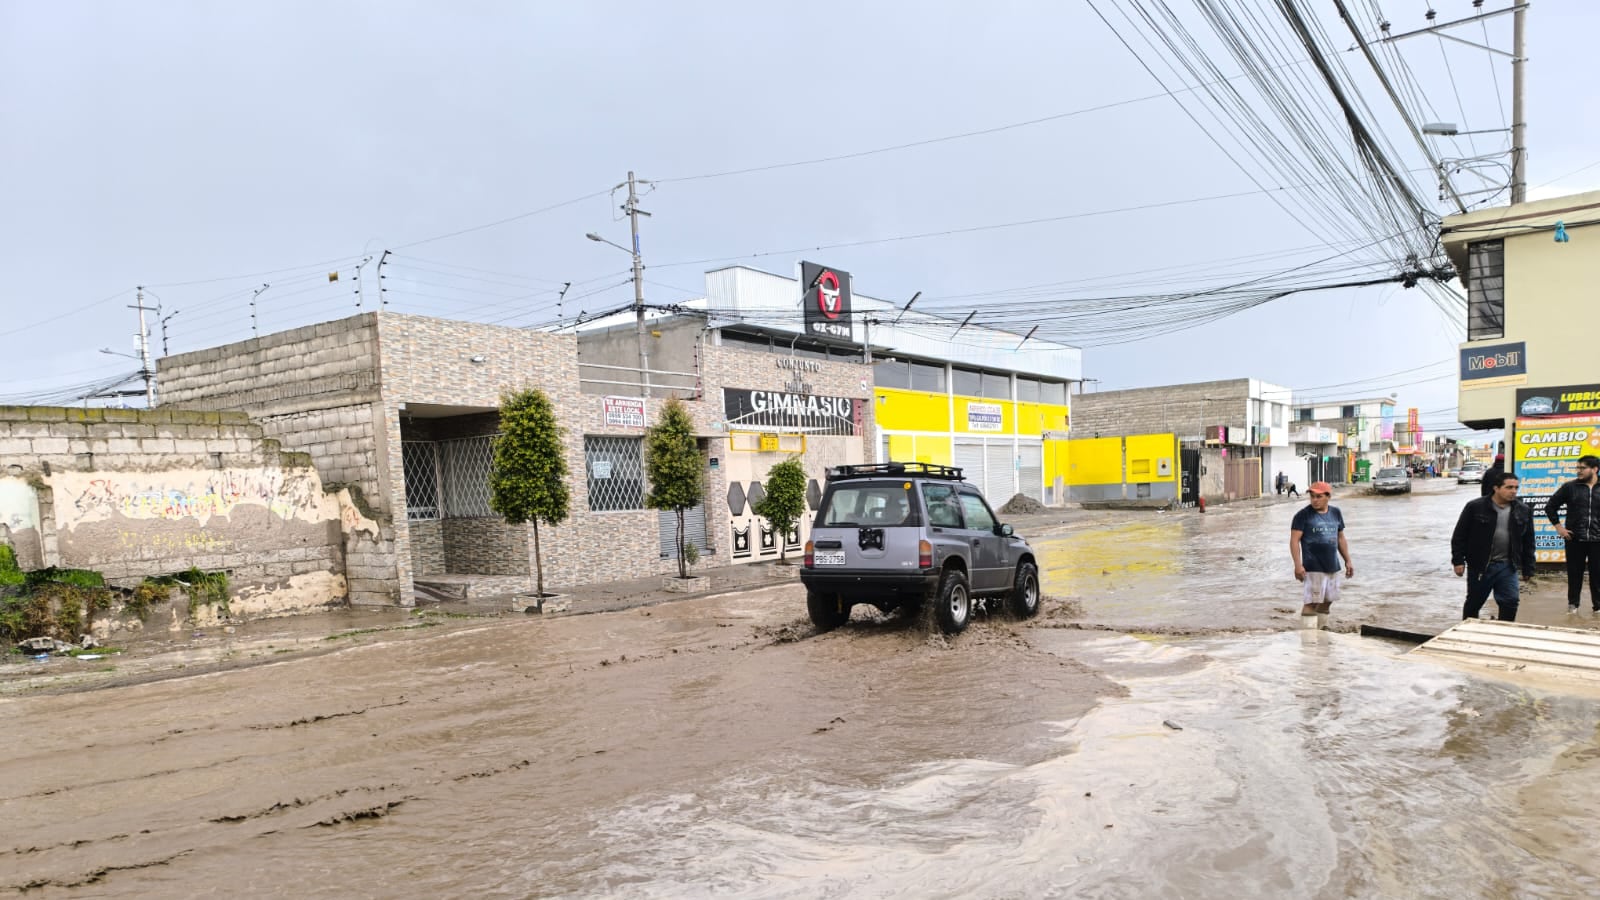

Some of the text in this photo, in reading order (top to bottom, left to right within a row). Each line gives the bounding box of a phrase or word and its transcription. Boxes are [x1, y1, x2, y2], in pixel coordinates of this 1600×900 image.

[776, 359, 821, 373] CONJUNTO
[1469, 351, 1518, 371] Mobil
[750, 391, 851, 418] GIMNASIO
[1520, 431, 1588, 444] CAMBIO
[1525, 445, 1582, 458] ACEITE
